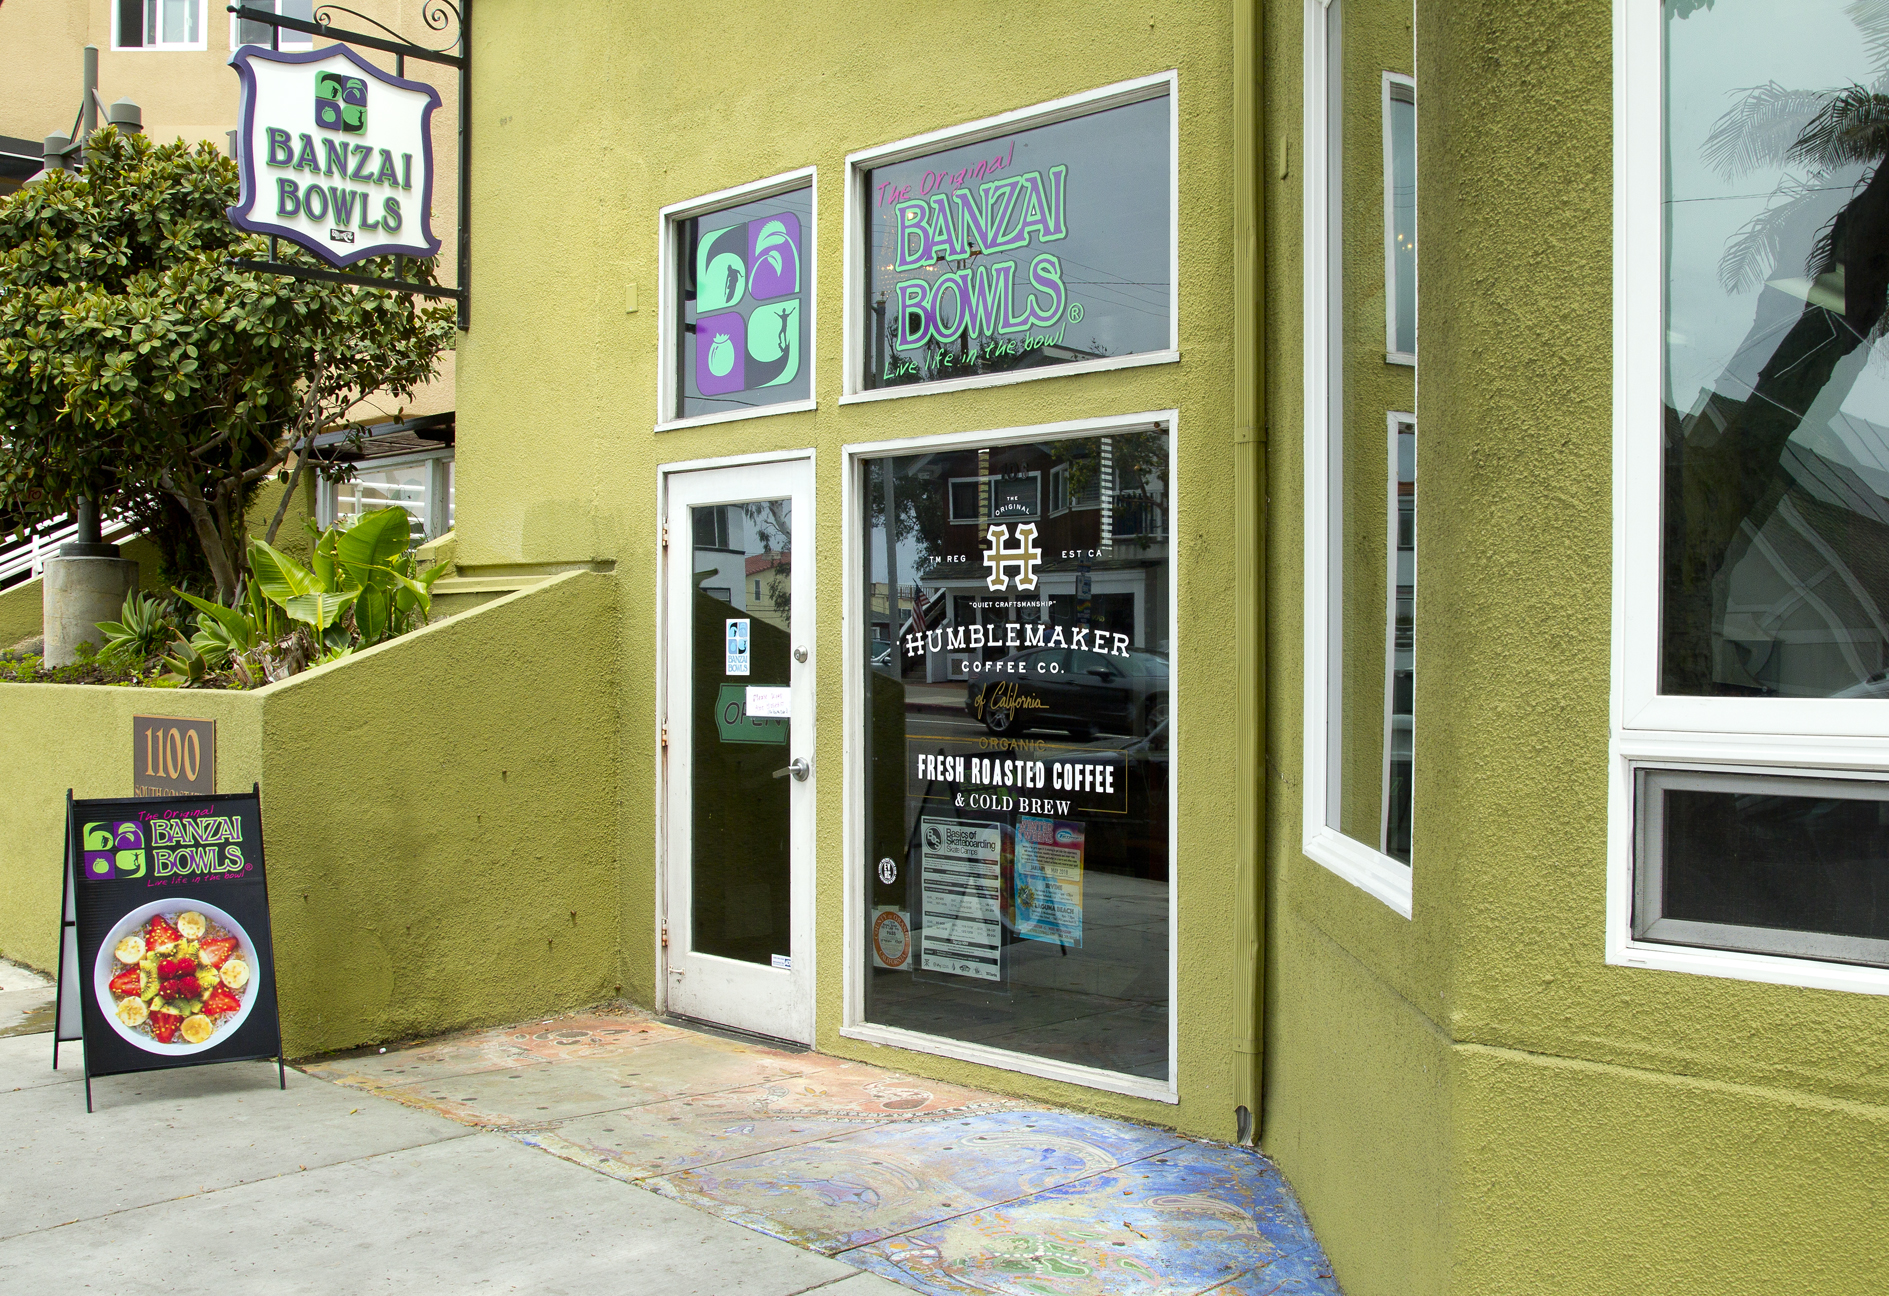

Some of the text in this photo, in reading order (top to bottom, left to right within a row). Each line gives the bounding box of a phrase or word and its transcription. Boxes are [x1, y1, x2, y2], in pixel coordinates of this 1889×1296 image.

[266, 126, 412, 190] BANZAI
[877, 141, 1015, 207] The Original
[276, 177, 402, 234] BOWLS
[895, 164, 1068, 272] BANZAI
[896, 254, 1066, 351] BOWLS
[884, 322, 1066, 380] Live life in the bowl
[995, 504, 1030, 516] ORIGINAL
[947, 555, 966, 563] REG
[1062, 549, 1102, 559] EST CA
[906, 624, 1131, 658] HUMBLEMAKER
[728, 655, 748, 664] BANZAI
[728, 664, 748, 672] BOWLS
[962, 662, 1065, 674] COFFEE CO.
[974, 681, 1049, 720] of California
[144, 727, 200, 781] 1100
[978, 737, 1047, 752] ORGANIC
[918, 754, 1114, 794] FRESH ROASTED COFFEE
[138, 804, 214, 821] The Original
[955, 792, 1071, 816] & COLD BREW
[150, 816, 243, 846] BANZAI
[946, 828, 976, 839] Basics of
[946, 838, 996, 851] Skateboarding
[946, 846, 978, 855] Skate Camps
[154, 845, 245, 877] BOWLS
[171, 876, 188, 884] life
[224, 870, 244, 879] bowl
